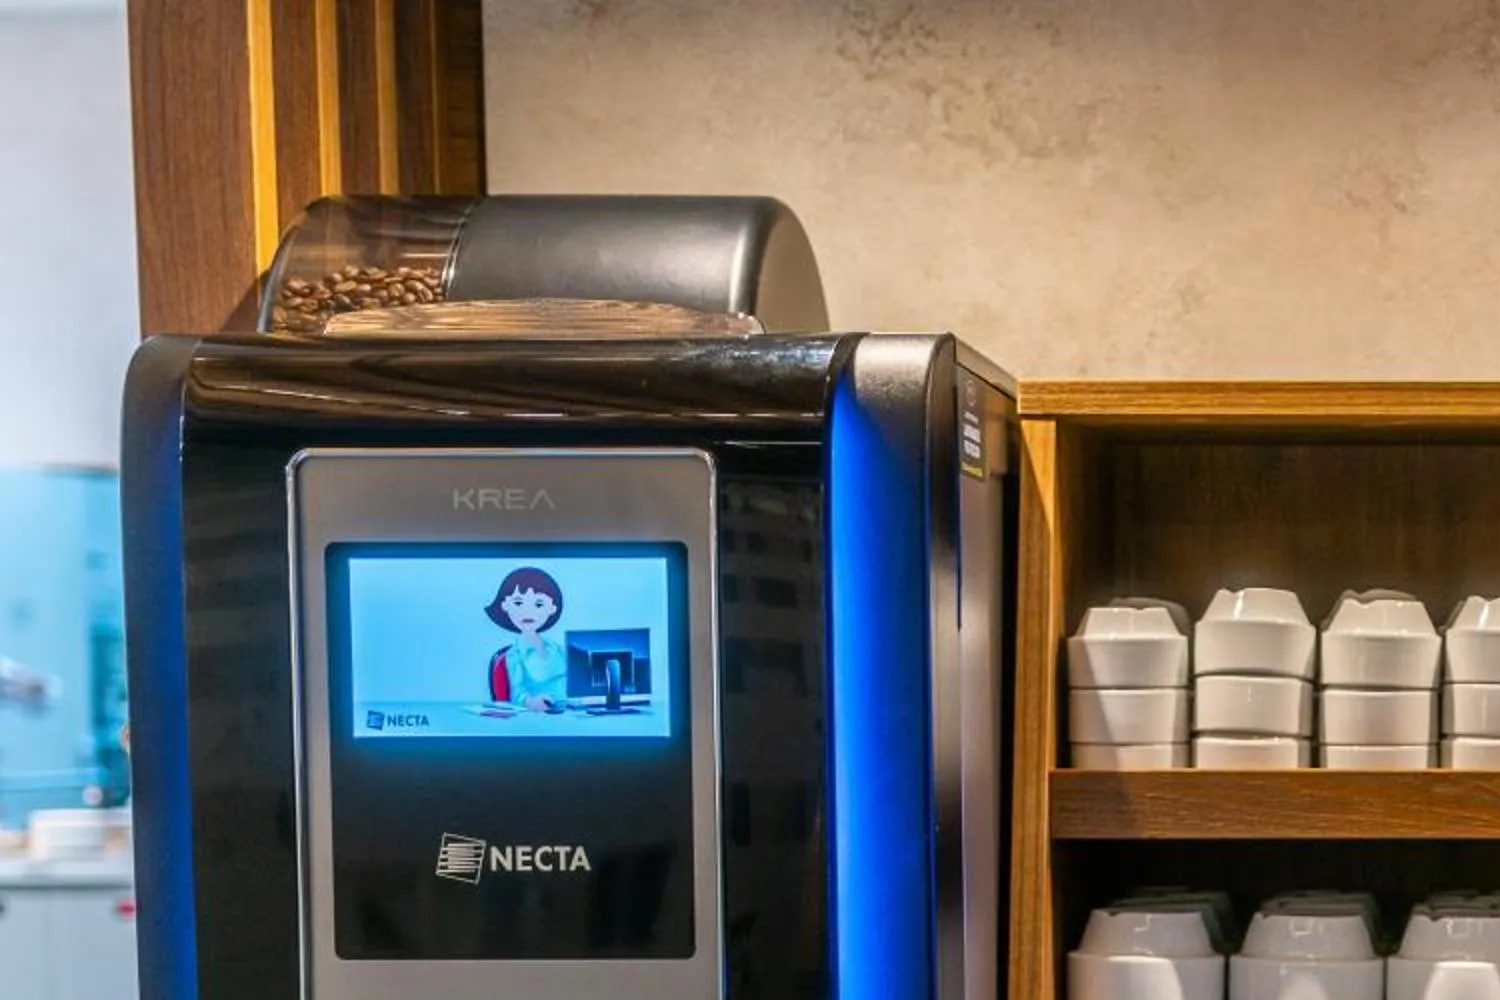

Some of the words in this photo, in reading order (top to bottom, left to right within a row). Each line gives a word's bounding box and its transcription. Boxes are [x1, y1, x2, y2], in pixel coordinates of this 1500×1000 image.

[453, 488, 556, 511] KREA
[387, 714, 429, 727] NECTA
[490, 845, 592, 872] NECTA
